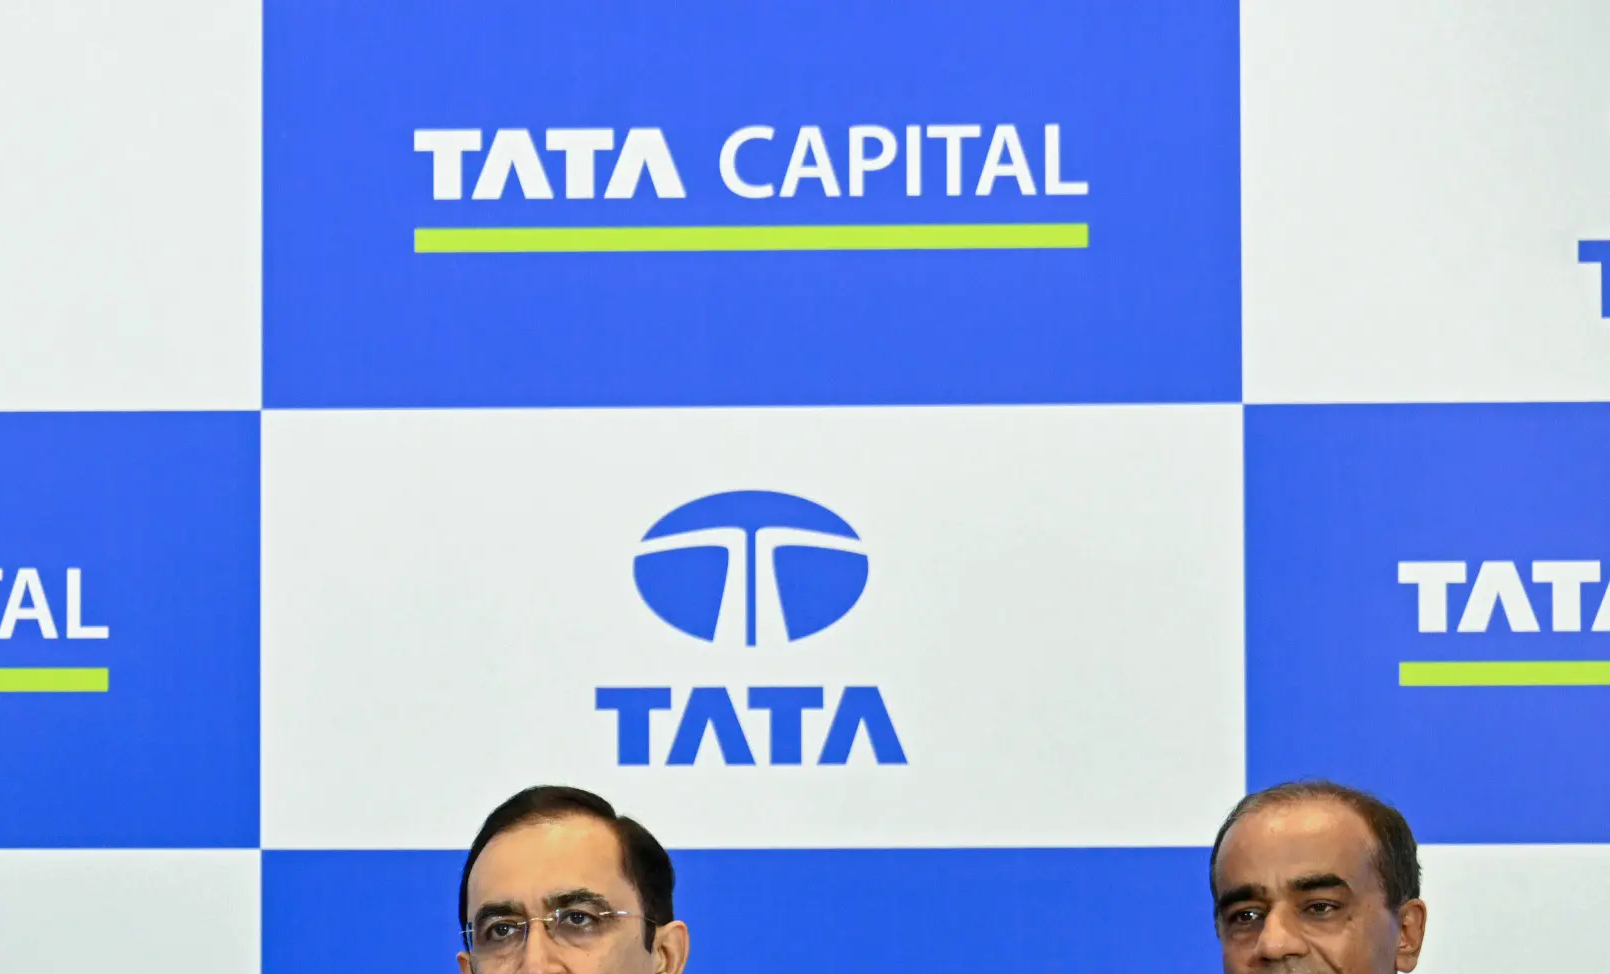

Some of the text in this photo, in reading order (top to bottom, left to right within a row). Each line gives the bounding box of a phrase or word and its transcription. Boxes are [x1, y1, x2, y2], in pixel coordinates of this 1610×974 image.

[414, 124, 1088, 200] TATA CAPITAL
[1398, 561, 1610, 632] TAT
[596, 687, 907, 765] TATA
